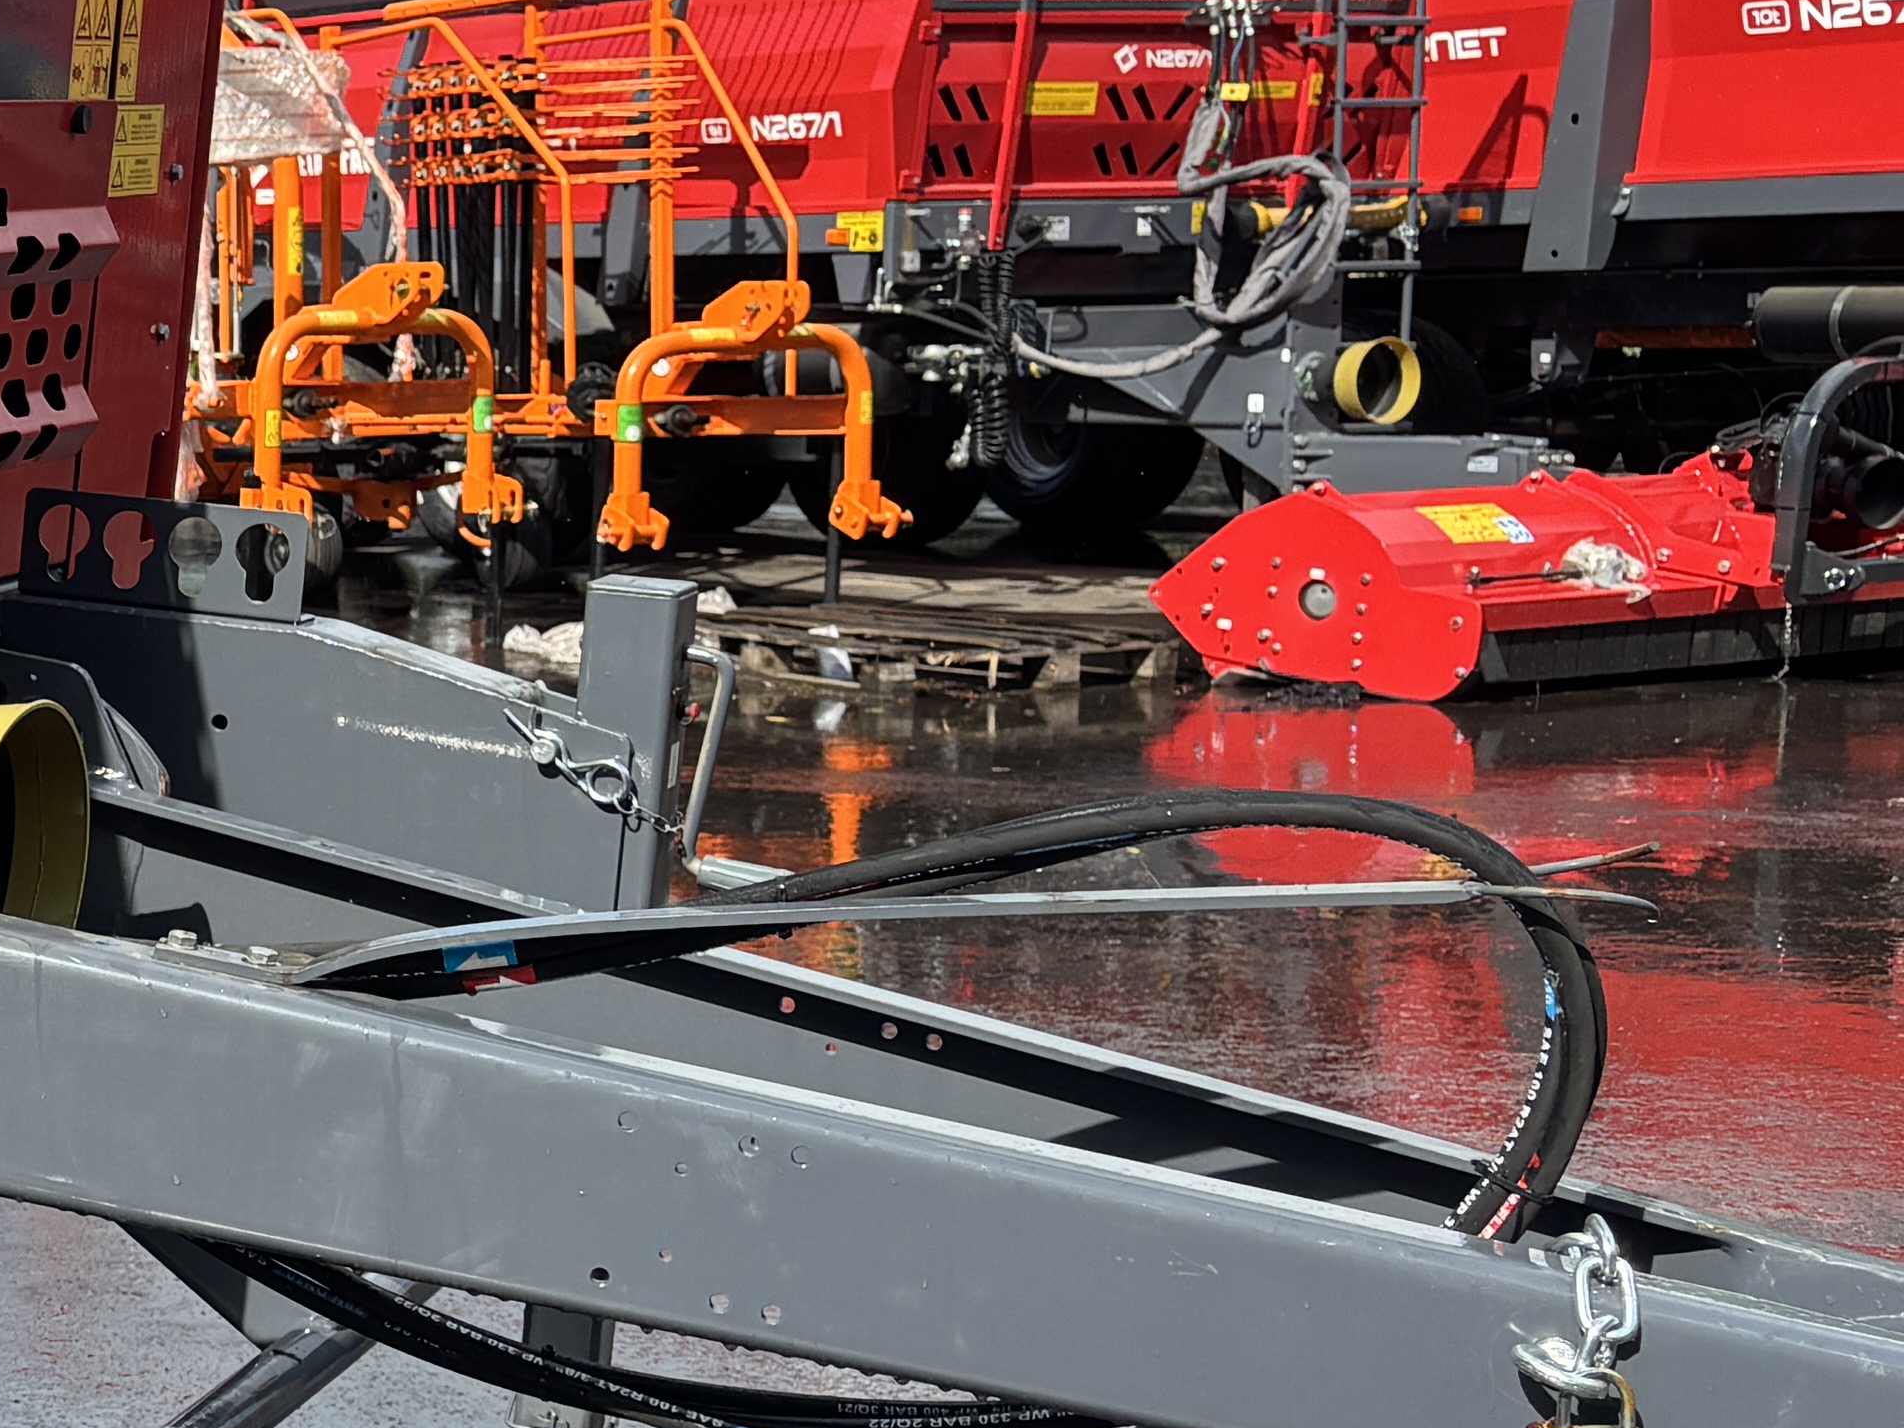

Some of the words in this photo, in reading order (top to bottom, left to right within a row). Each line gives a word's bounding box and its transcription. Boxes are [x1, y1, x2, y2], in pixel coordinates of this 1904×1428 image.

[1425, 26, 1507, 62] NET
[868, 1418, 923, 1428] 2Q/22
[929, 1416, 971, 1427] BAR
